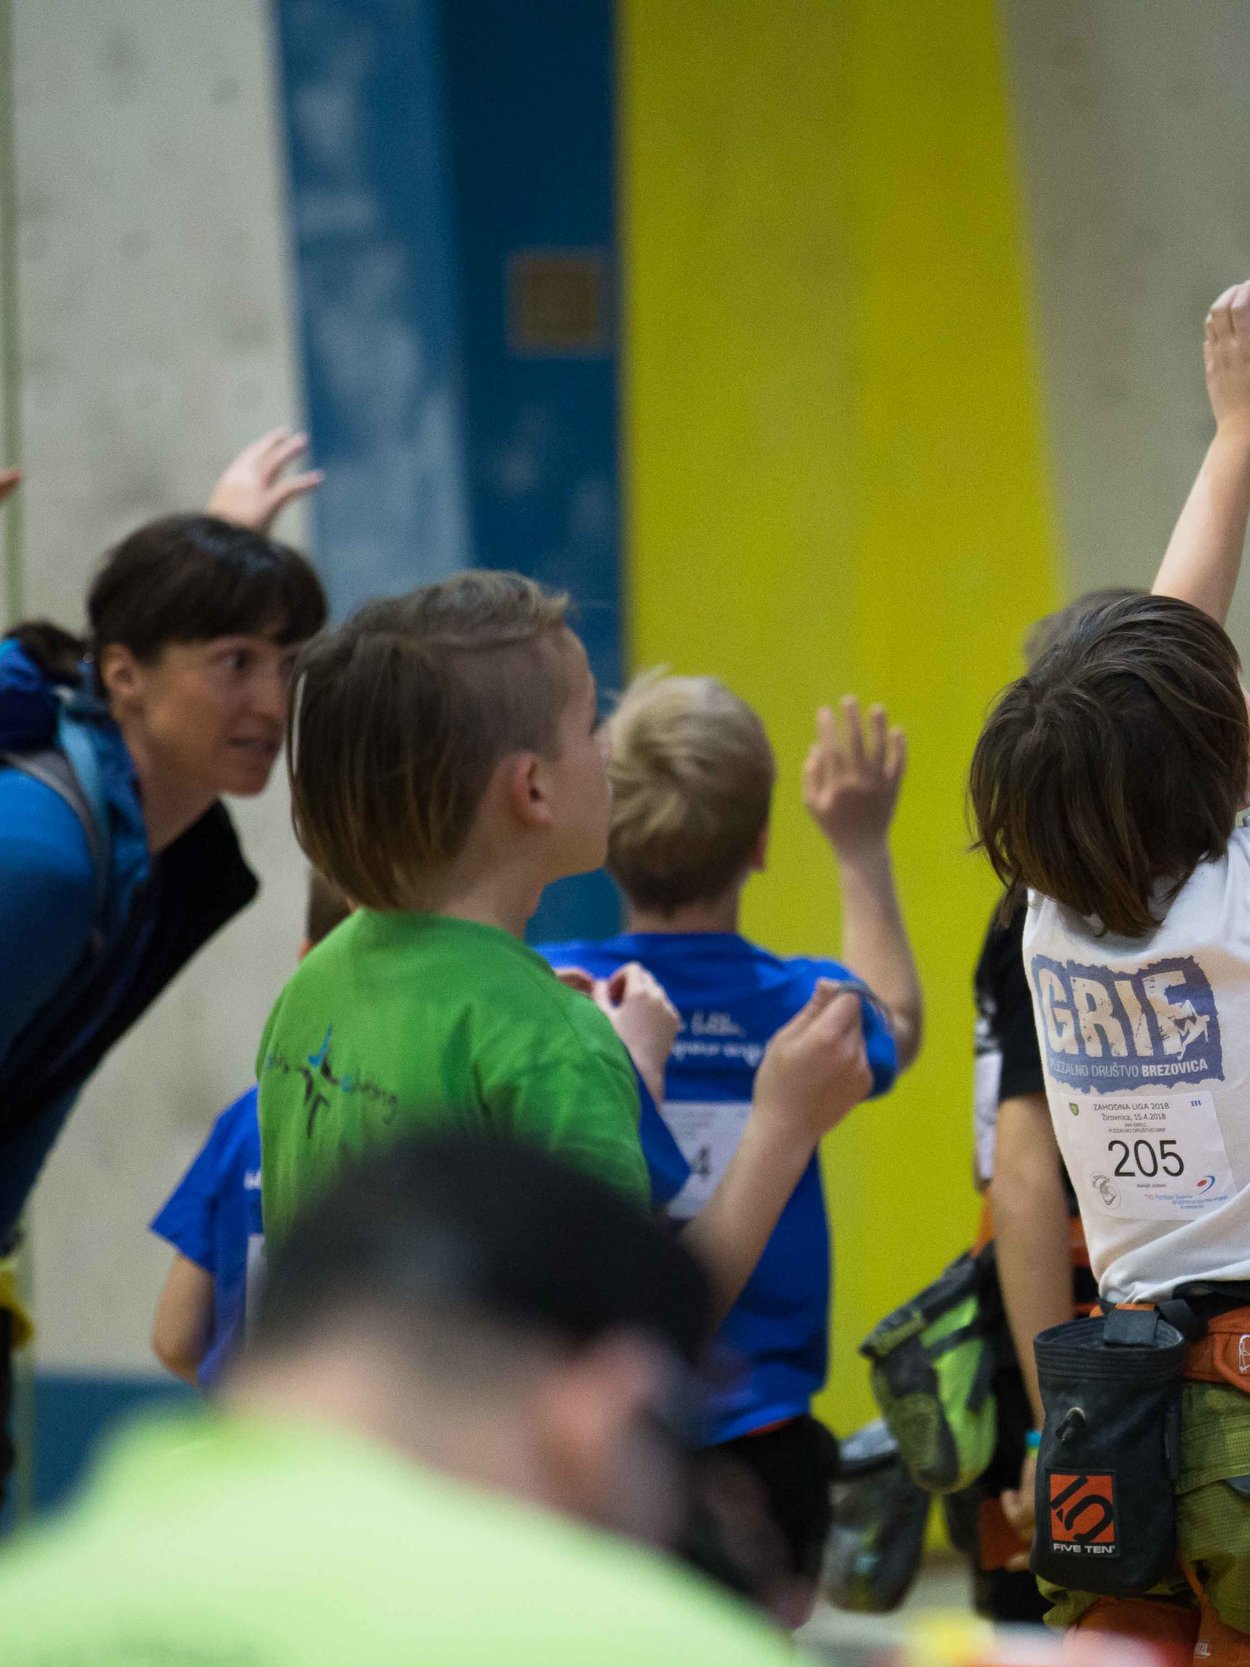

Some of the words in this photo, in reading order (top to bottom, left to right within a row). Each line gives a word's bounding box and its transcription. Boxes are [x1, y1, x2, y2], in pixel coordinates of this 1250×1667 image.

[1091, 1062, 1139, 1078] DRUŠTVO
[1141, 1058, 1209, 1077] BREZOVICA
[1093, 1103, 1130, 1112] ZAHODNA
[1132, 1103, 1150, 1111] LIGA
[1151, 1102, 1170, 1110] 2018
[1107, 1139, 1185, 1178] 205
[1053, 1543, 1082, 1553] FIVE
[1084, 1545, 1113, 1554] TEN
